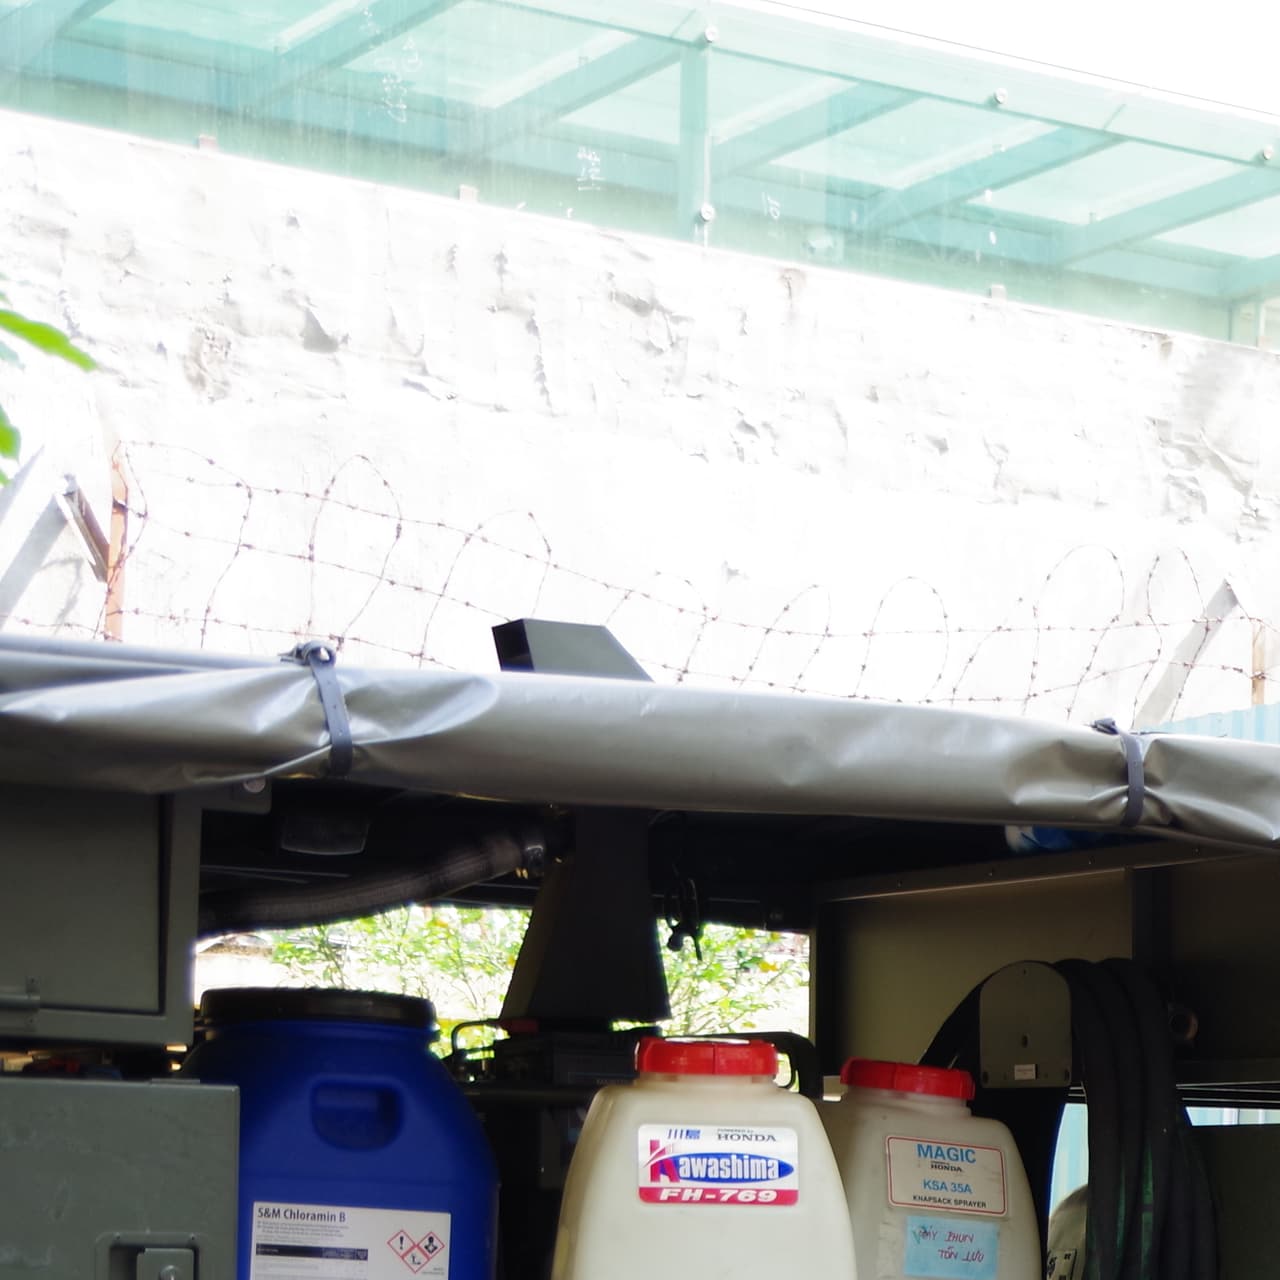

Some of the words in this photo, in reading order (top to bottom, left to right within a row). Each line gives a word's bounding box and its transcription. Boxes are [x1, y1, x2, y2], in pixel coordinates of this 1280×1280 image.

[717, 1133, 777, 1142] HONDA
[647, 1139, 780, 1183] Kawashima
[916, 1143, 977, 1164] MAGIC
[930, 1163, 963, 1173] HONDA
[923, 1179, 948, 1192] KSA
[950, 1182, 972, 1194] 35A
[659, 1188, 778, 1203] FH-769
[913, 1195, 953, 1205] KNAPSACK
[954, 1199, 987, 1208] SPRAYER
[257, 1207, 281, 1220] S&M
[283, 1208, 337, 1223] Chloramin
[339, 1212, 346, 1223] B
